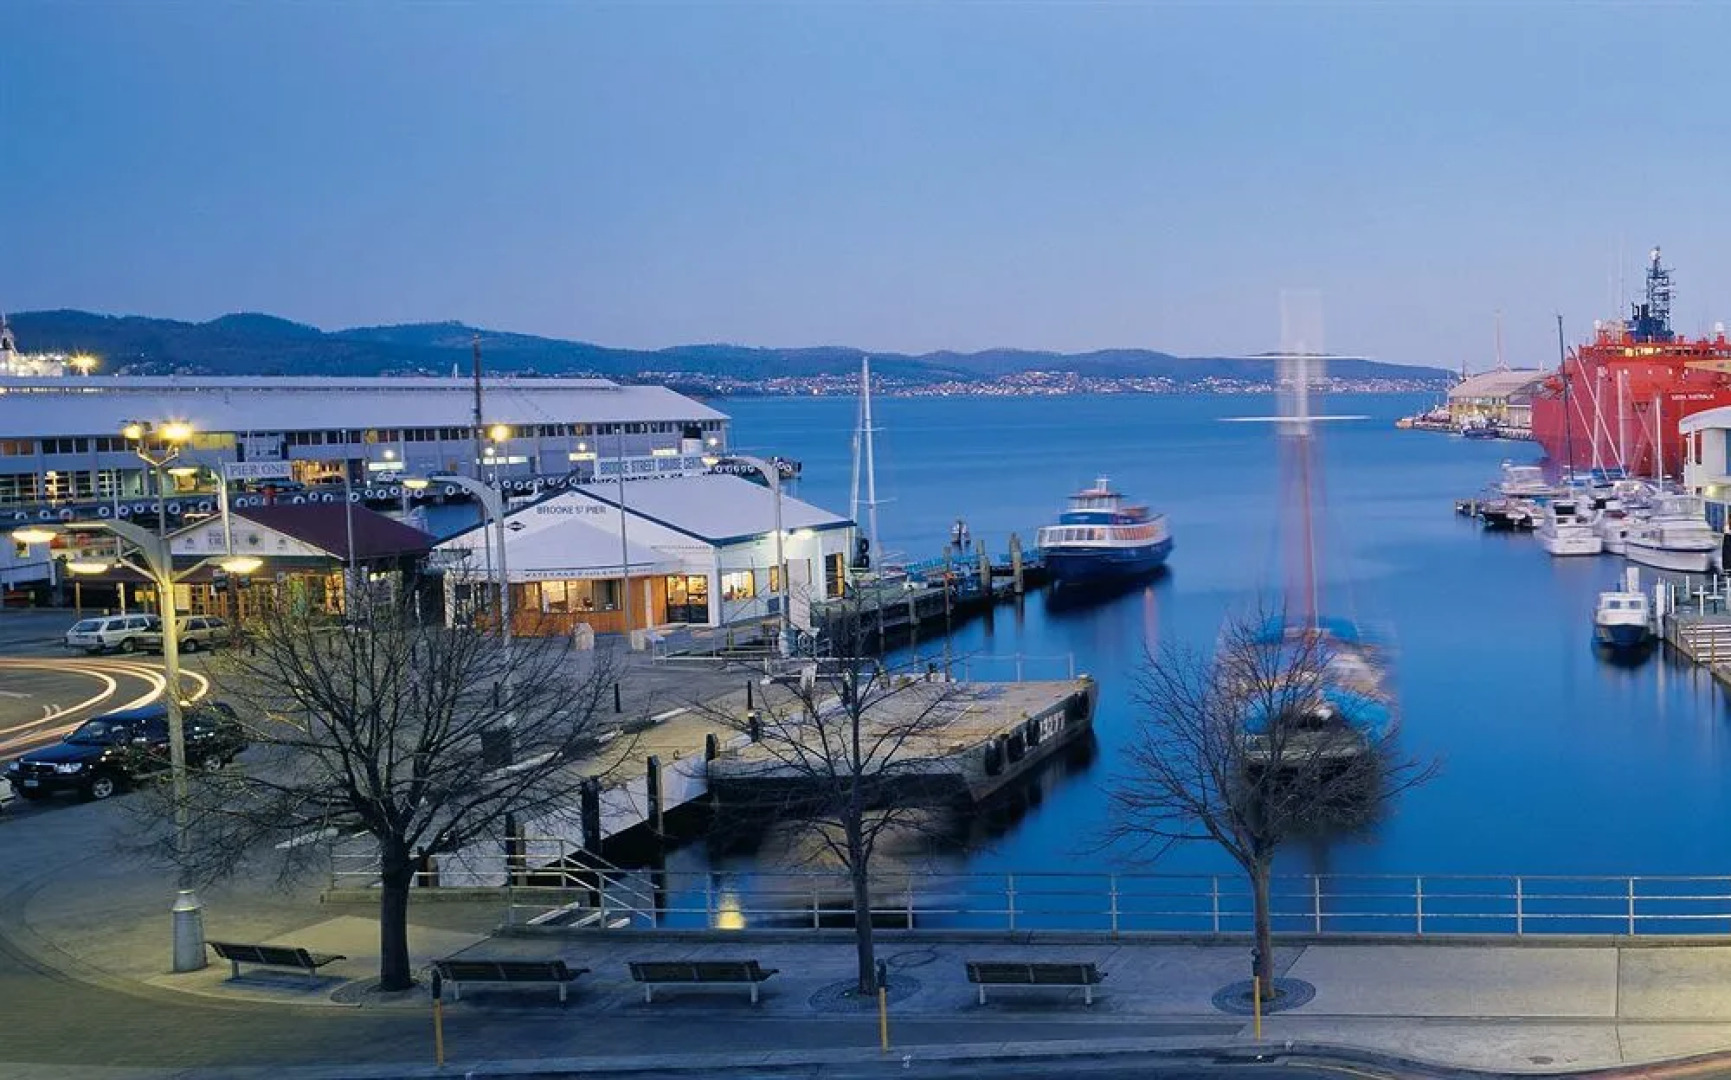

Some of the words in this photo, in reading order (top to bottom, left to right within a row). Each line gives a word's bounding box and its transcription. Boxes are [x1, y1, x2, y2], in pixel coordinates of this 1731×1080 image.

[229, 464, 258, 477] PIER
[261, 464, 288, 476] ONE
[537, 505, 573, 515] BROOKE
[586, 505, 607, 515] PIER
